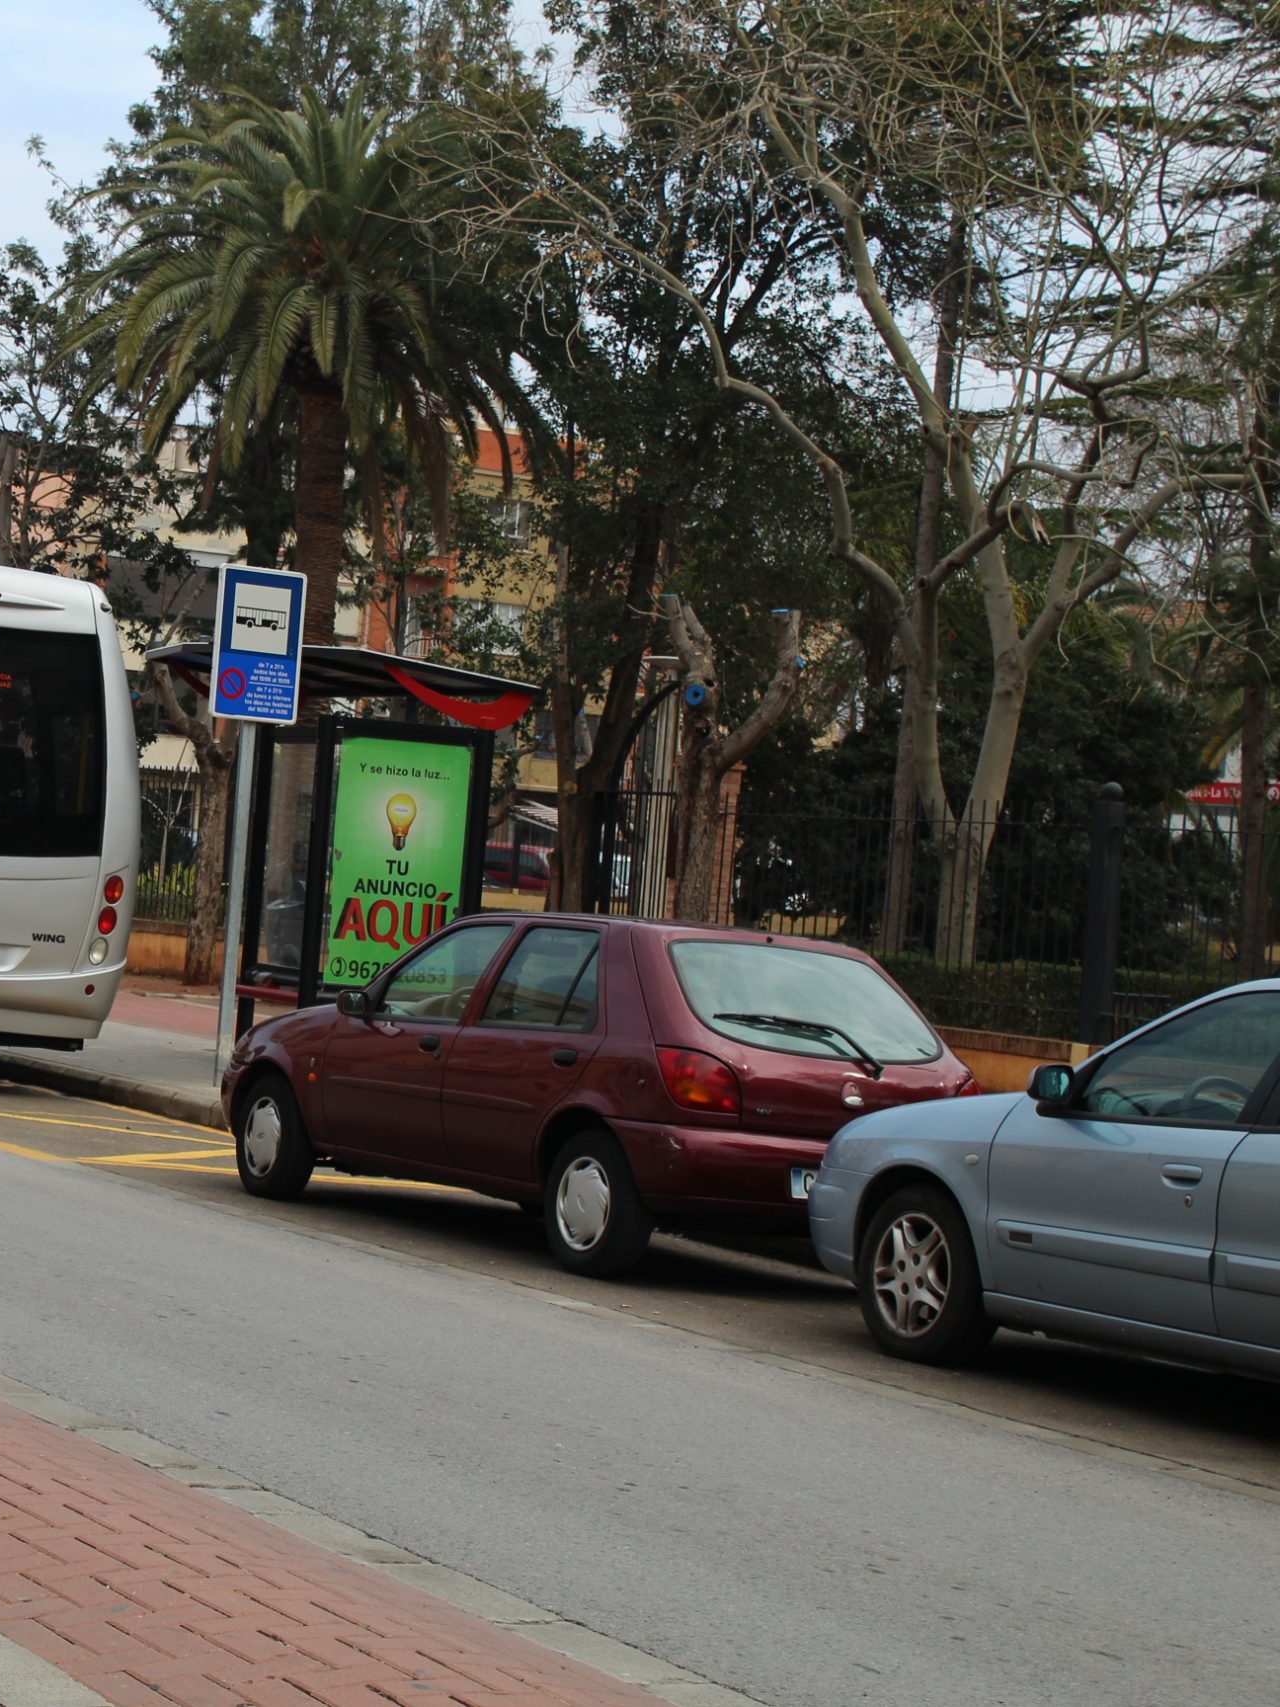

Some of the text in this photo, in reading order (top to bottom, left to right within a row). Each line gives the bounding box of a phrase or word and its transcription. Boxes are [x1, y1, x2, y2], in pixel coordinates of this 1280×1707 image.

[359, 762, 367, 773] Y
[370, 764, 382, 774] se
[386, 765, 408, 777] hizo
[412, 766, 421, 778] la
[386, 859, 410, 876] TU
[353, 878, 438, 899] ANUNCIO
[333, 892, 453, 951] AQUÍ
[32, 932, 66, 944] WING
